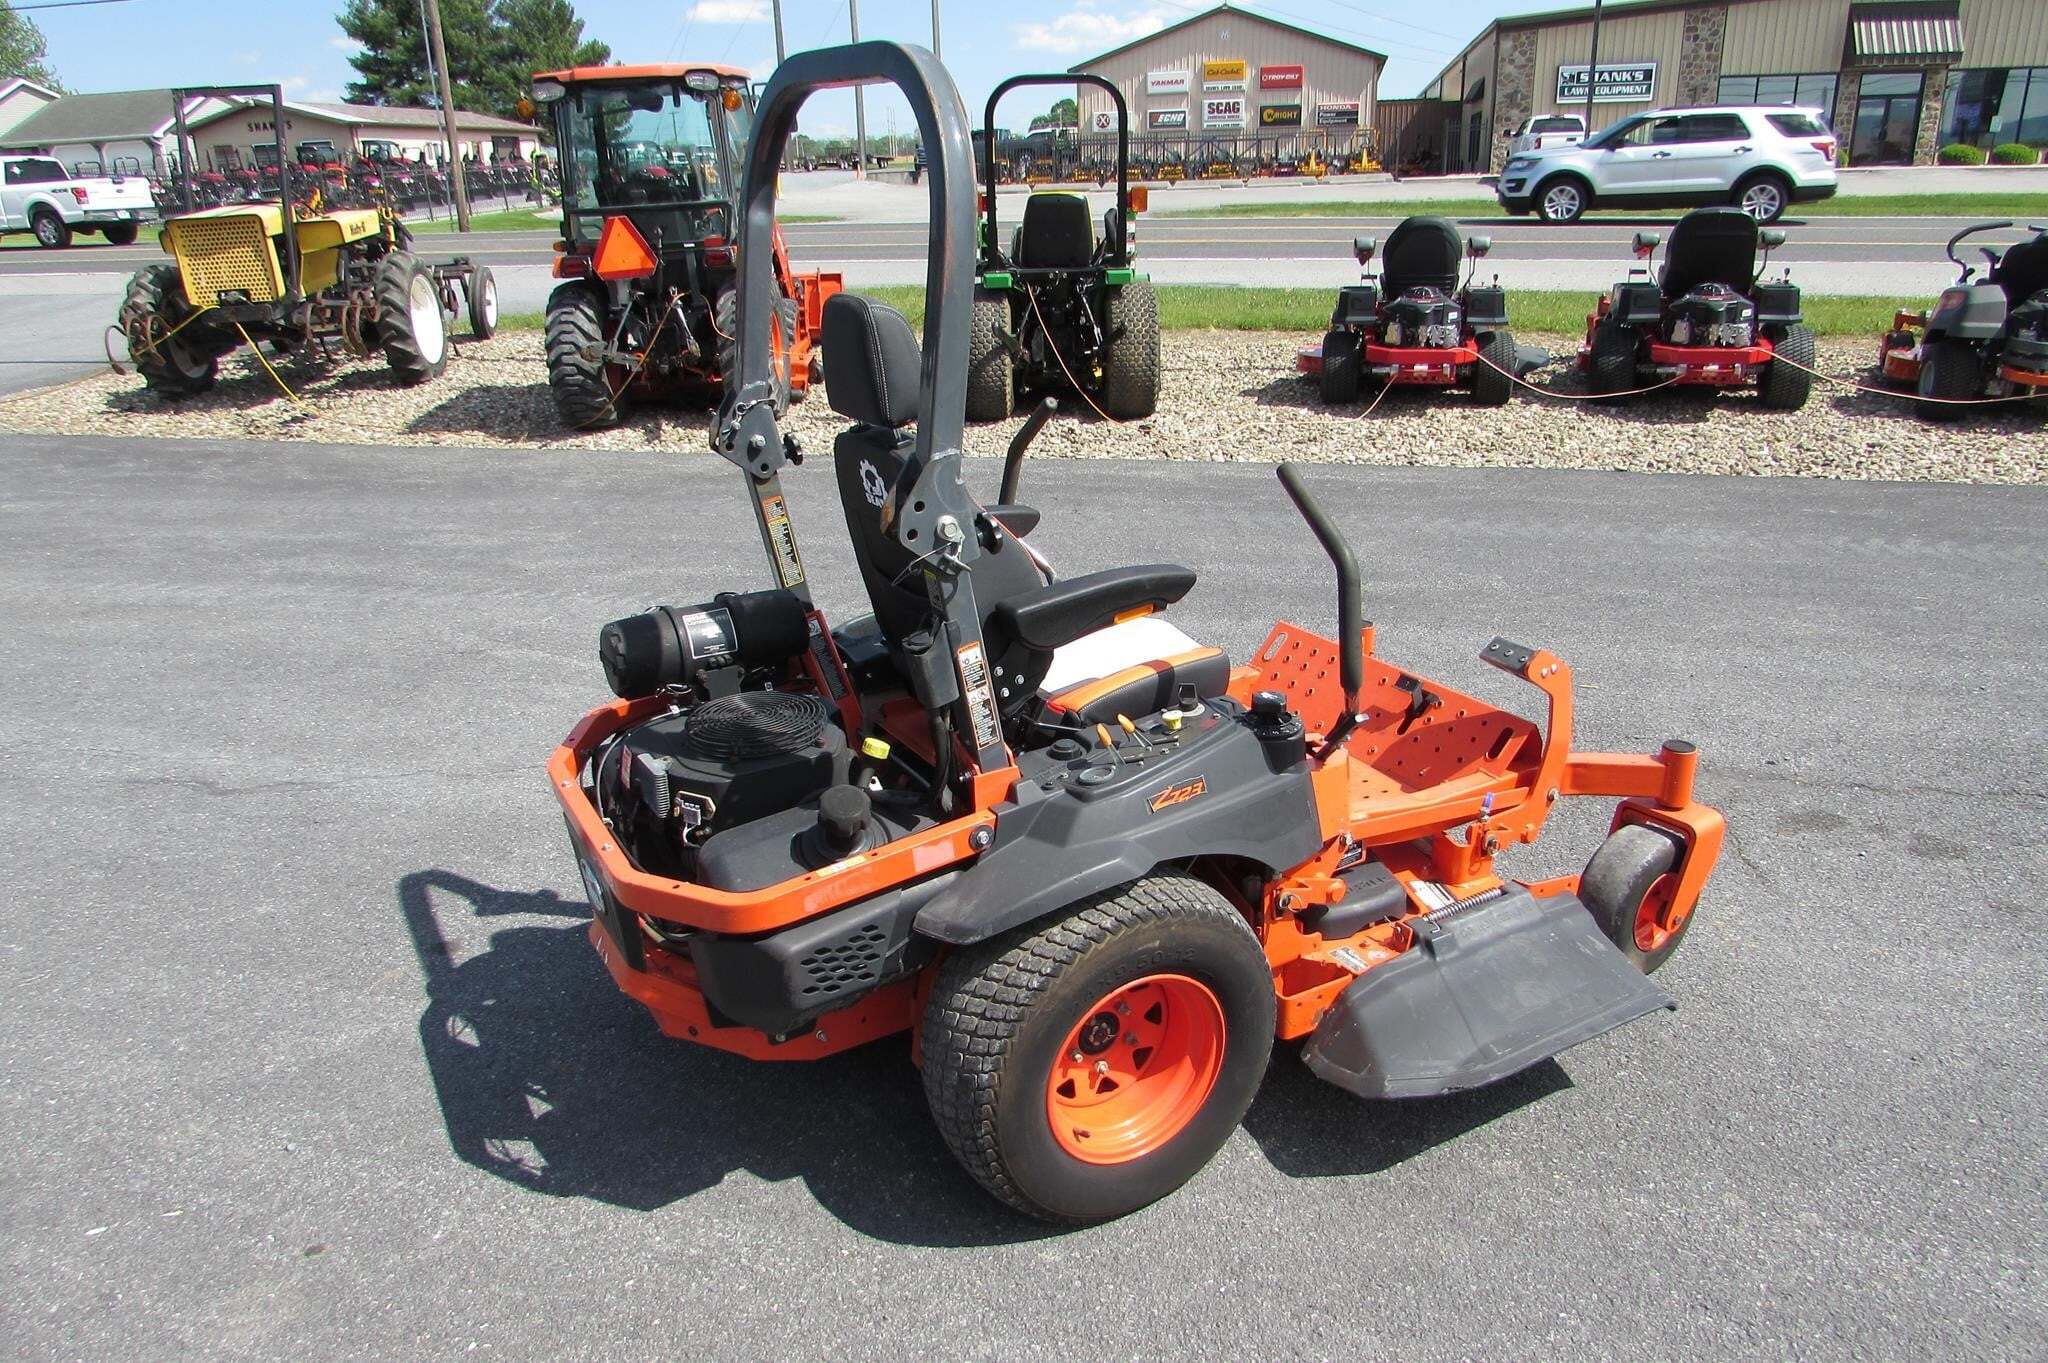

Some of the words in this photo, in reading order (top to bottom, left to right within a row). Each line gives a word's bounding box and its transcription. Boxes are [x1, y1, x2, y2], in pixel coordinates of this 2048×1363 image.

[1580, 71, 1644, 82] SANK'S
[1595, 85, 1648, 95] EQUIPMENT
[1207, 101, 1240, 115] SCAG
[1158, 113, 1185, 123] ECHO
[1152, 781, 1204, 812] Z723
